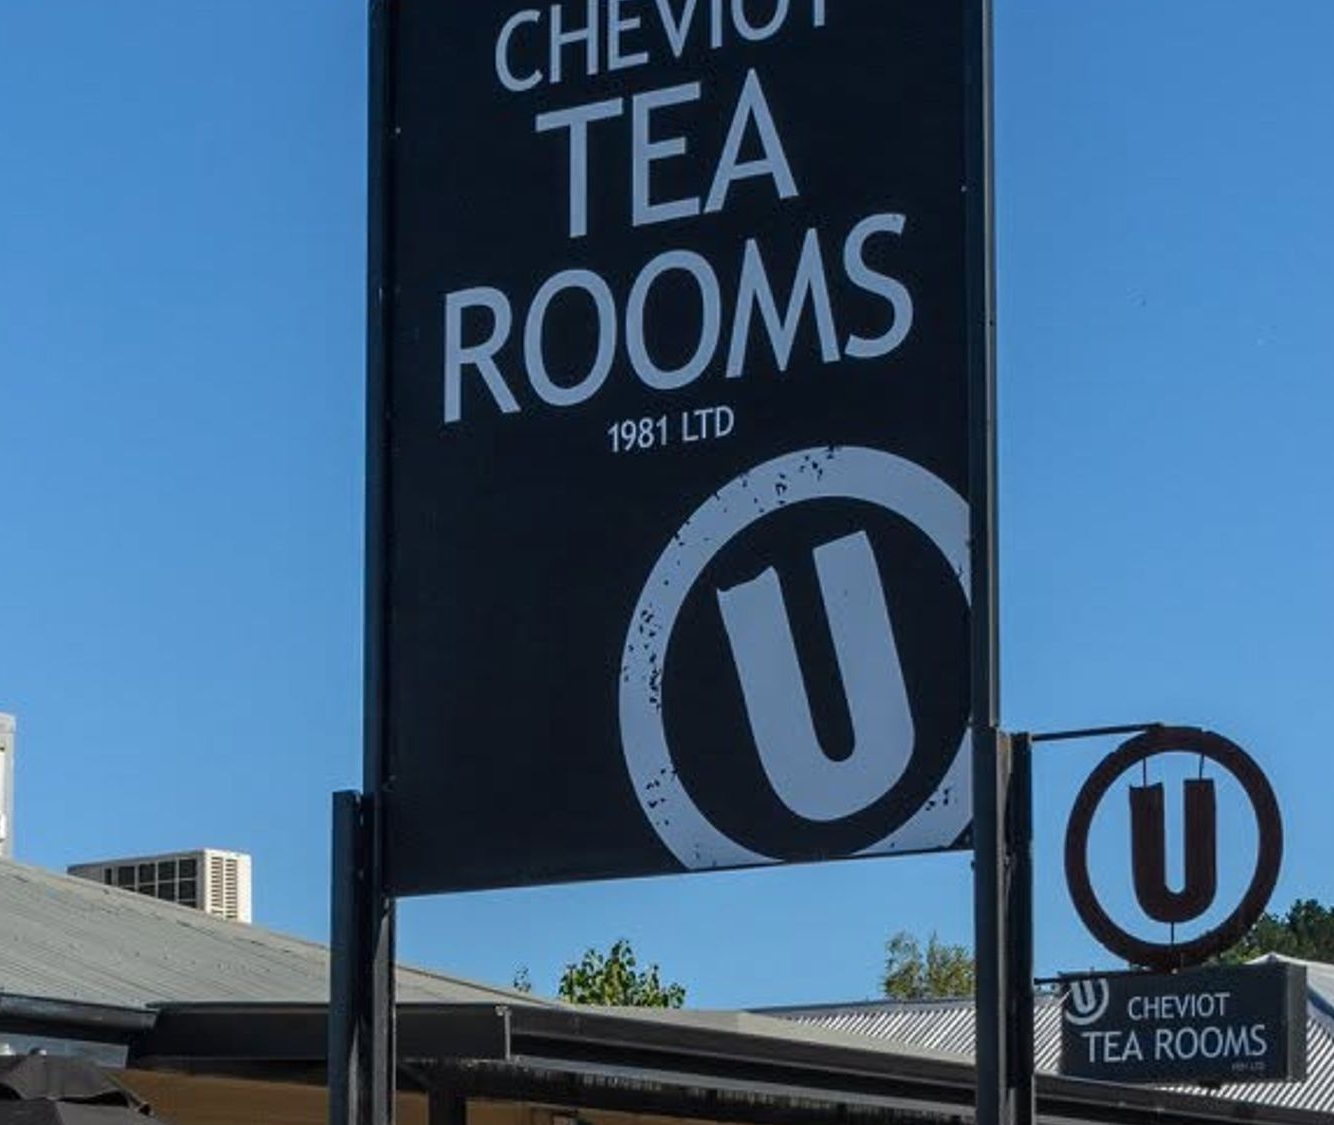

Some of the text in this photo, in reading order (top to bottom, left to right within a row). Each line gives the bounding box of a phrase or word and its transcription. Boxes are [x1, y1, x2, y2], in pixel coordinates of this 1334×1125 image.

[536, 68, 799, 239] TEA
[443, 213, 914, 424] ROOMS
[607, 406, 734, 453] 1981 LTD
[716, 530, 915, 822] U
[1129, 778, 1217, 924] U
[1081, 1023, 1267, 1063] TEA ROOMS
[1127, 992, 1231, 1021] CHEVIOT
